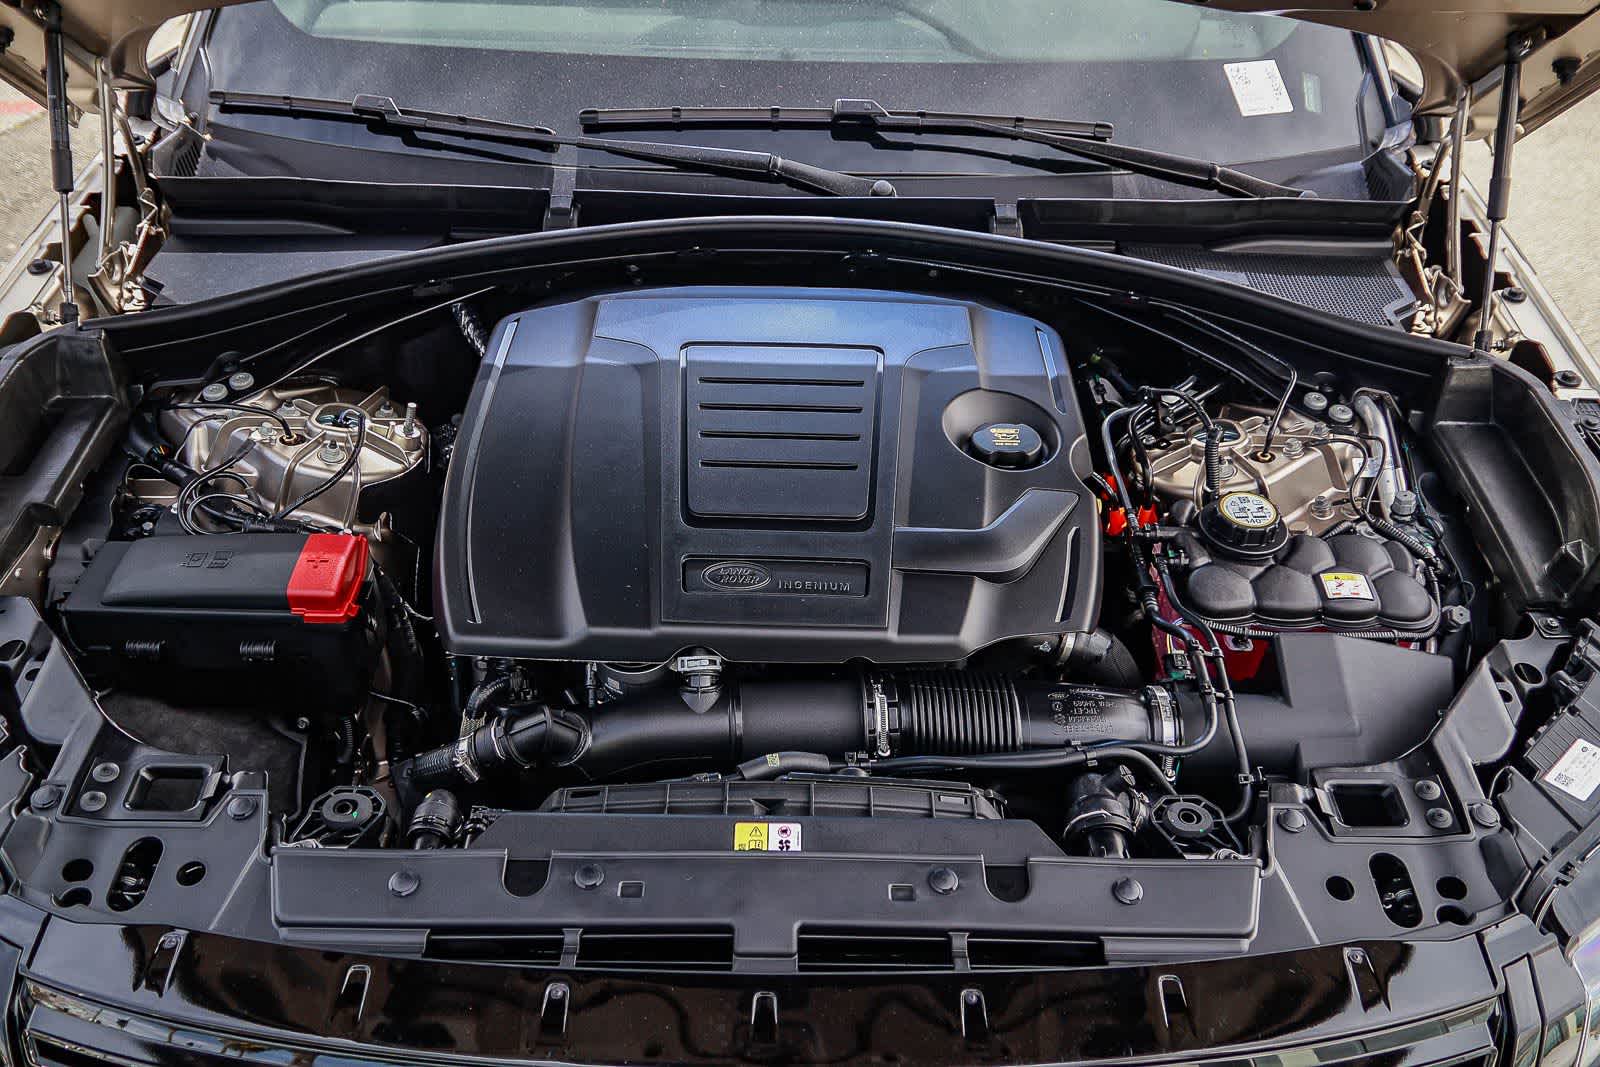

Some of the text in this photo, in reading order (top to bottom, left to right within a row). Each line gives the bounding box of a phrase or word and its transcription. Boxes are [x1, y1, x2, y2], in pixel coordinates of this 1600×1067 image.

[719, 567, 751, 575] LAND
[719, 575, 760, 584] ROVER
[778, 579, 850, 592] INGENIUM
